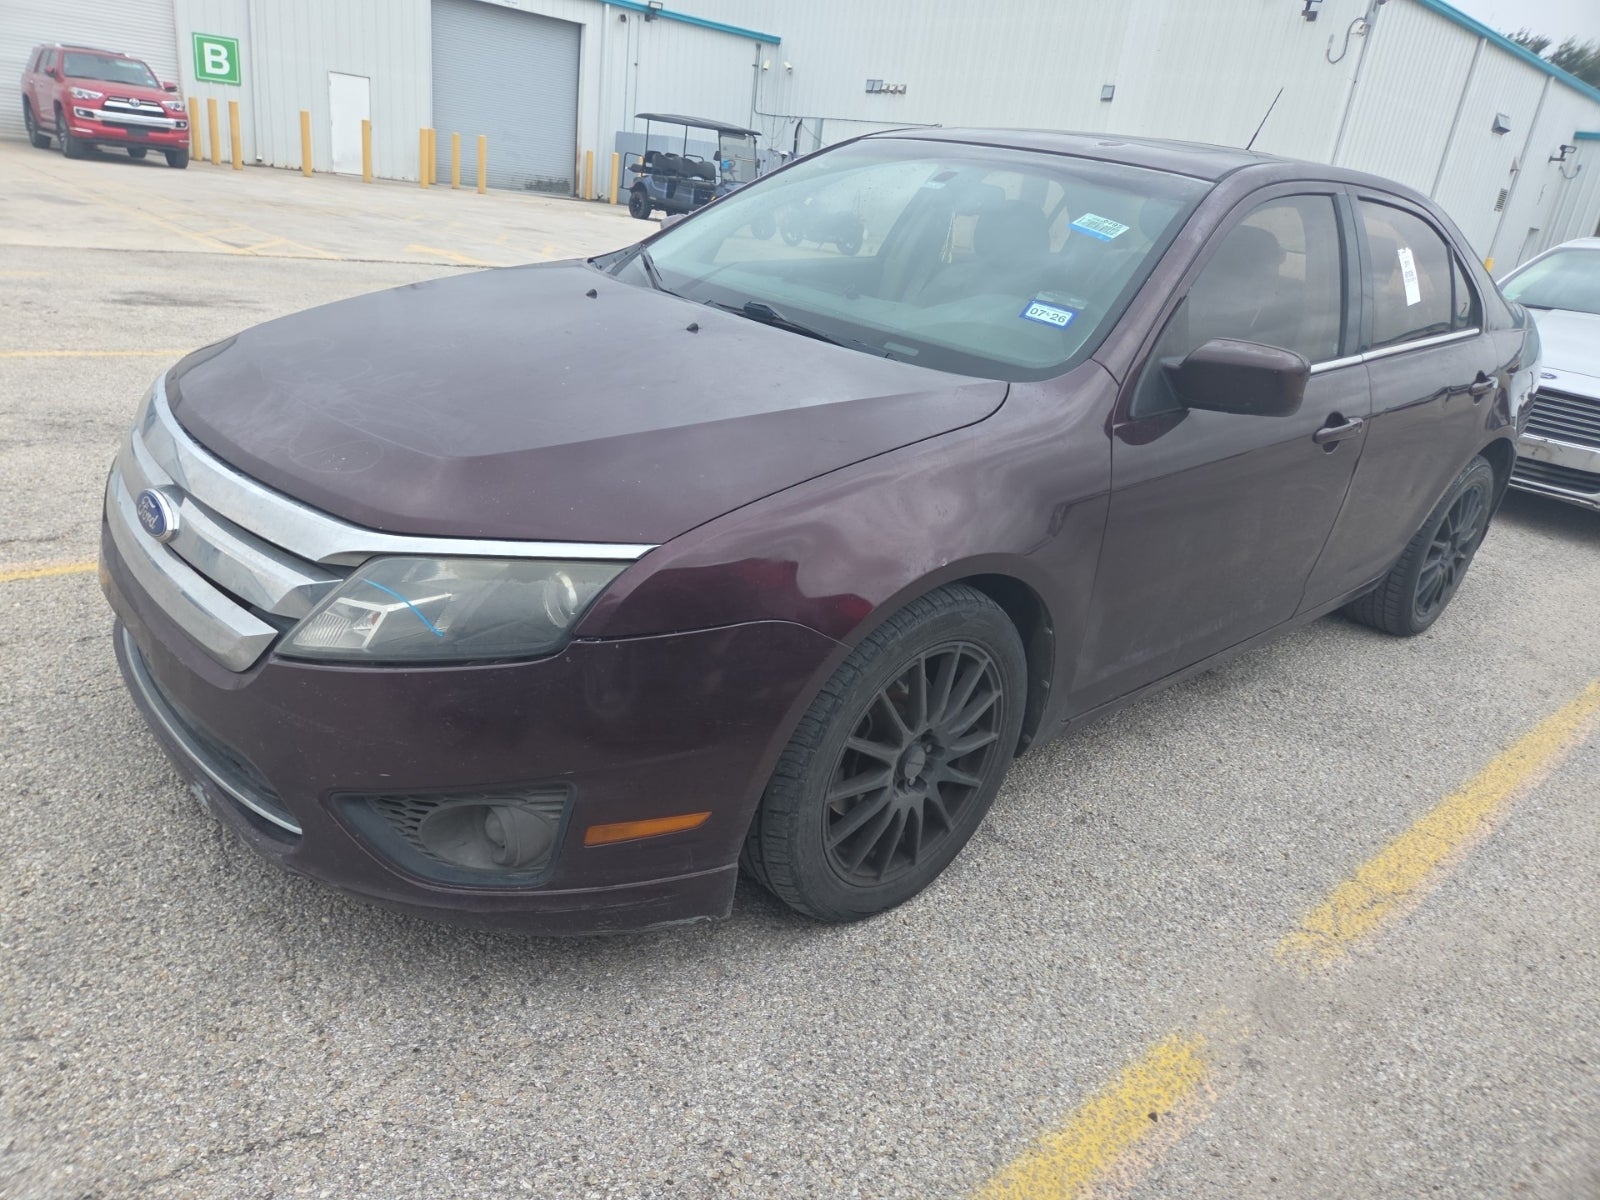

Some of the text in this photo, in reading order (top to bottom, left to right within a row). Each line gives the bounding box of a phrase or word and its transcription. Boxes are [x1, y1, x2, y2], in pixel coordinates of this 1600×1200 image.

[203, 42, 230, 75] B
[1030, 307, 1047, 317] 07
[1049, 313, 1067, 323] 26
[138, 495, 159, 530] Ford
